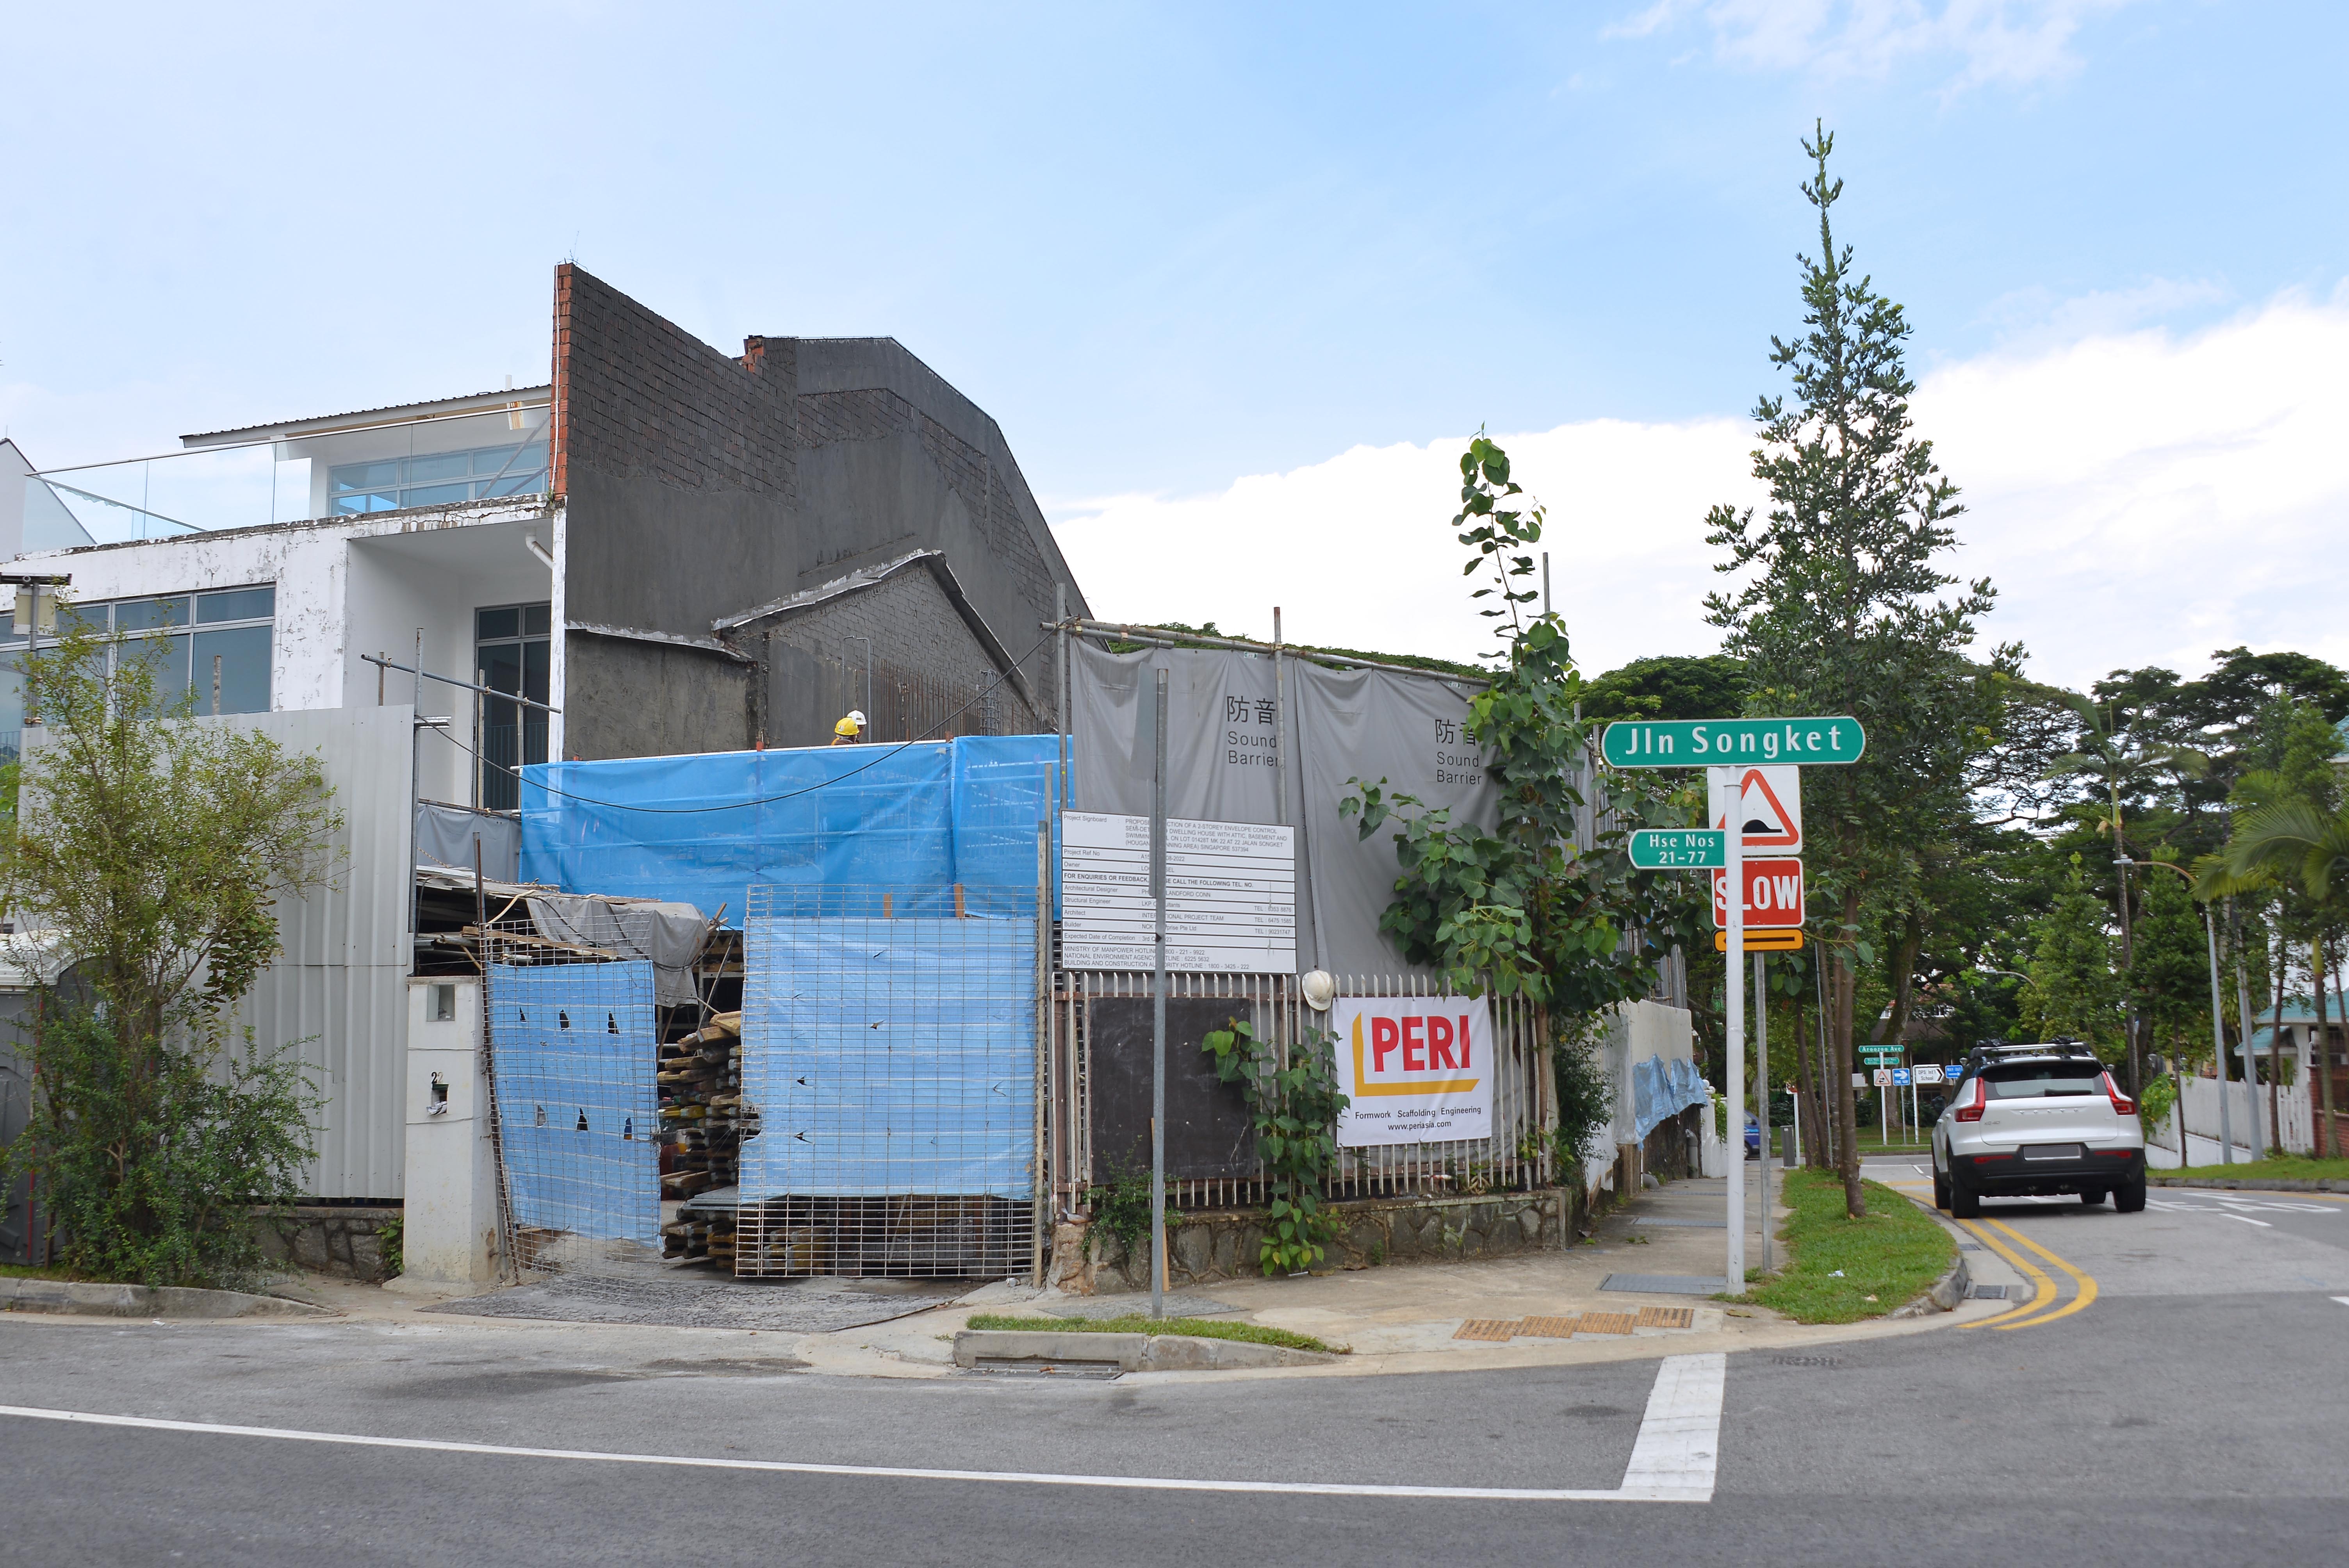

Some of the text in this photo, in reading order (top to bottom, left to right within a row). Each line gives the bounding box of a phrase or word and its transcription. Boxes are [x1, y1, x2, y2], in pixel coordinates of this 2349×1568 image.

[1227, 696, 1275, 725] 防音
[1228, 731, 1276, 748] Sound
[1625, 725, 1841, 759] Jln Songket
[1437, 752, 1479, 767] Sound
[1437, 770, 1482, 785] Barrier
[1650, 834, 1715, 847] Hse Nos
[1659, 852, 1706, 864] 21-77
[1371, 1015, 1470, 1072] PERI
[431, 1071, 444, 1084] 22
[1355, 1106, 1481, 1119] Formwork Scaffolding Engineering
[1388, 1120, 1451, 1131] www.periasia.com
